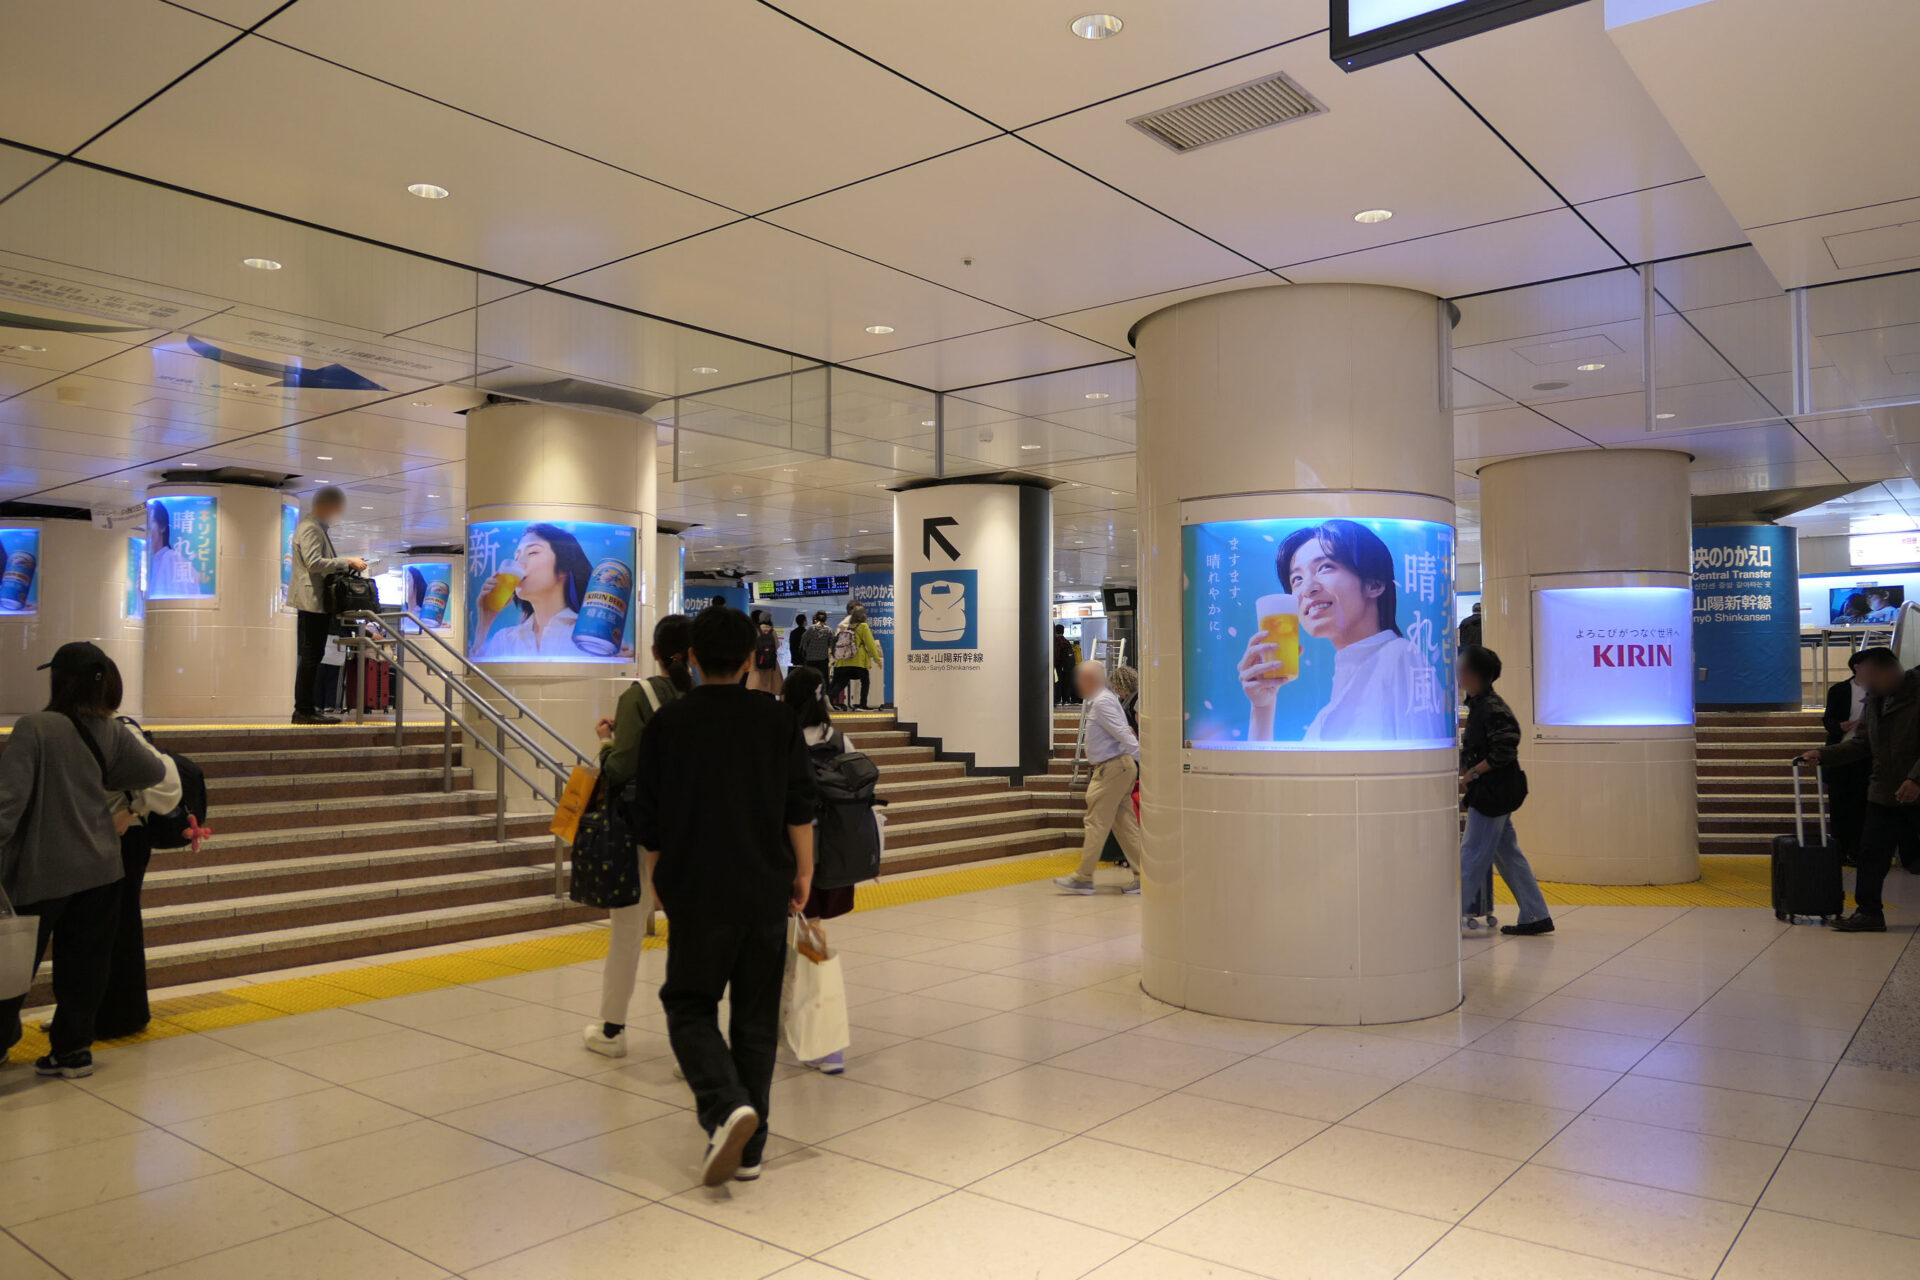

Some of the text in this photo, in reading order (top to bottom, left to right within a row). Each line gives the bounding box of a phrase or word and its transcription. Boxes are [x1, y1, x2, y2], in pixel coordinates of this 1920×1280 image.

[173, 510, 195, 583] 晴れ風
[197, 510, 211, 583] キリンビール
[469, 528, 500, 577] 新
[1228, 537, 1242, 607] ますます、
[1692, 569, 1772, 581] Central Transfer
[587, 592, 609, 602] KIRIN
[1206, 553, 1222, 640] 晴れやかに。
[1692, 594, 1772, 611] 山陽新幹線
[1715, 612, 1771, 623] Shinkansen
[1405, 551, 1440, 717] 晴れ風
[1576, 627, 1680, 640] よろこびがつなぐ世界へ
[906, 652, 984, 664] 東海道・山陽新幹線
[1593, 644, 1672, 667] KIRIN
